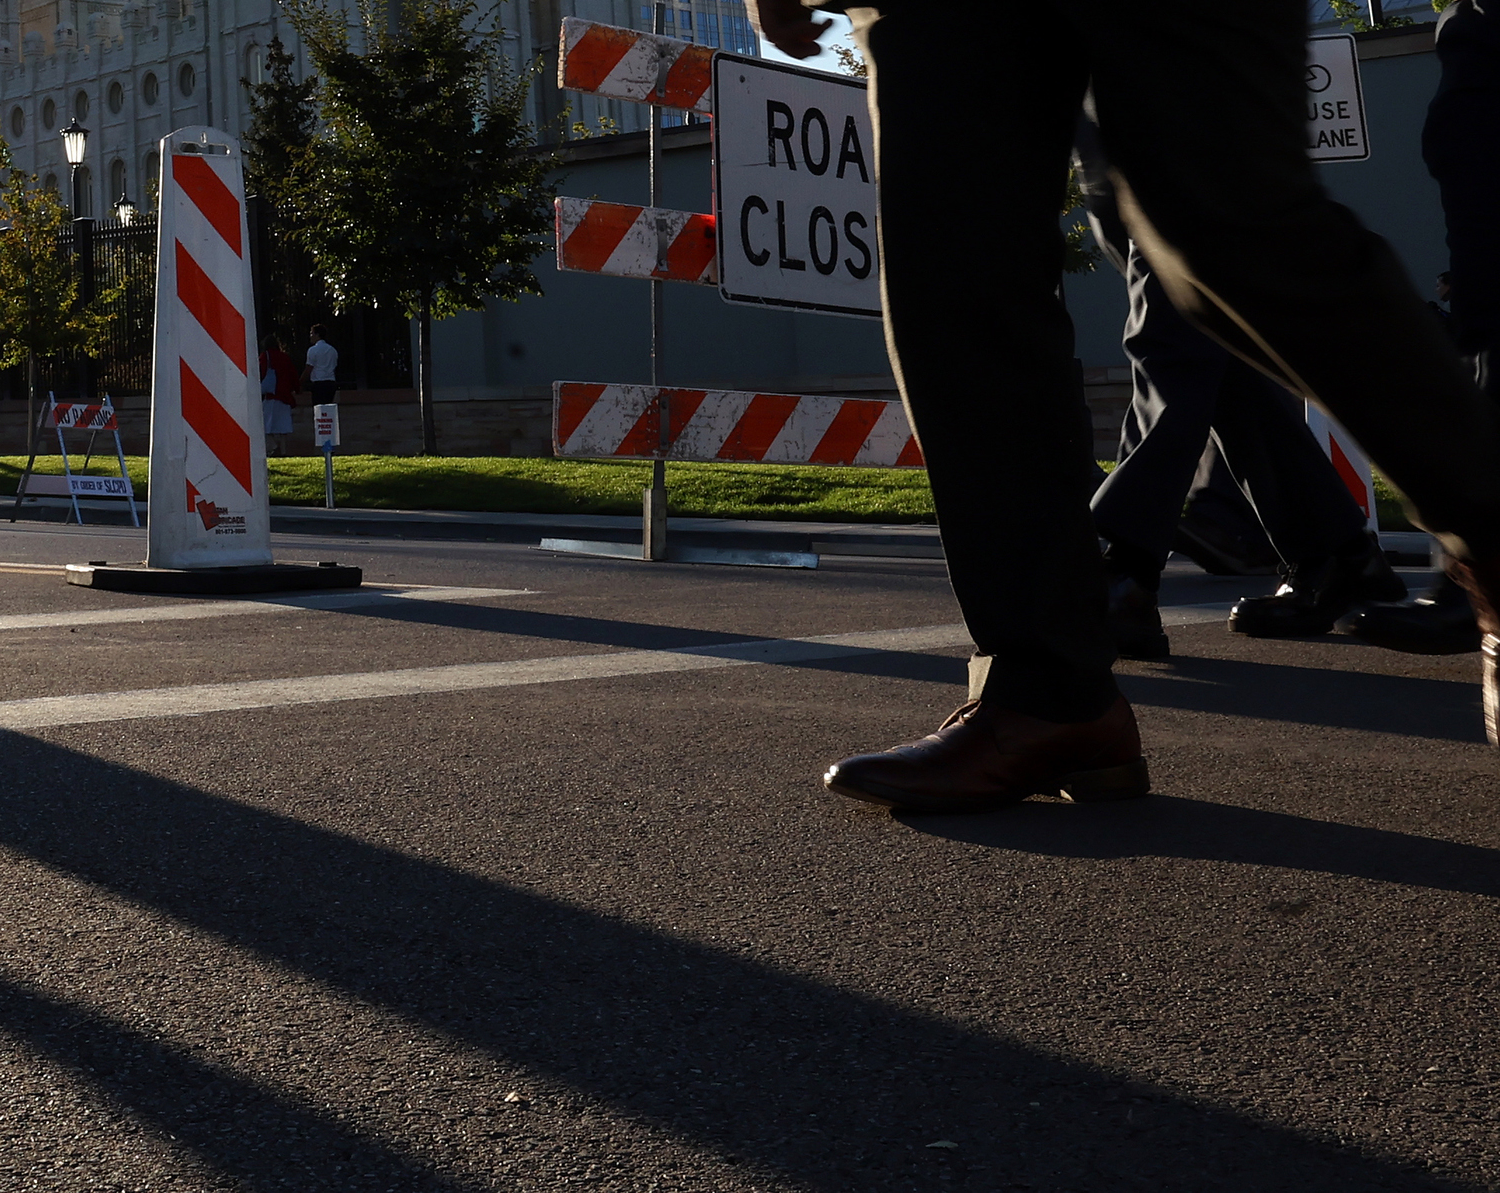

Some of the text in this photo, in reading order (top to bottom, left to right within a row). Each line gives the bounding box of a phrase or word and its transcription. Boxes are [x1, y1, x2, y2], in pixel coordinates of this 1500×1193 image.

[767, 99, 870, 184] ROA
[740, 195, 880, 280] CLOS
[54, 407, 71, 424] NO
